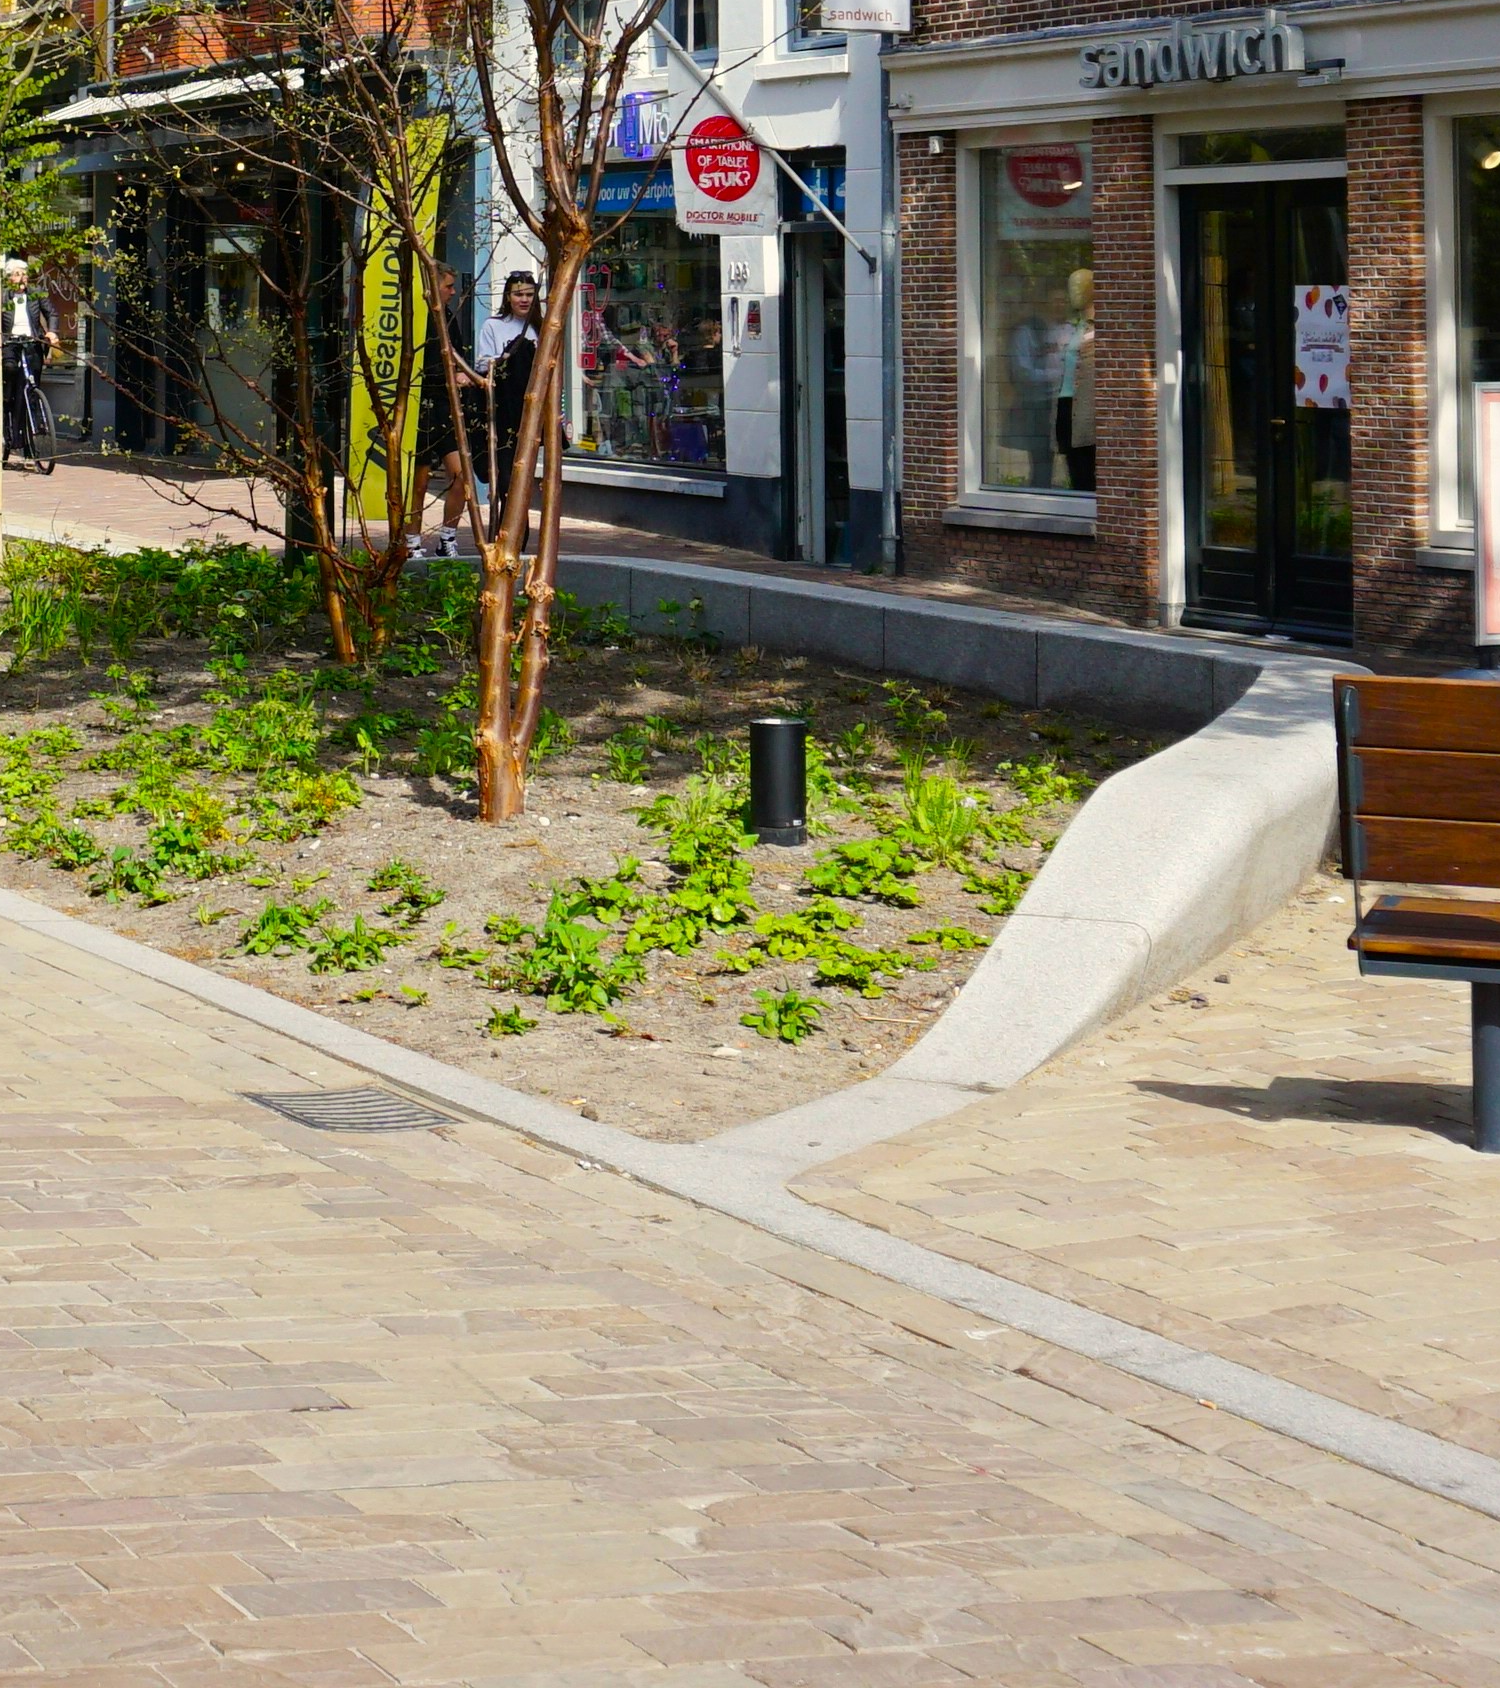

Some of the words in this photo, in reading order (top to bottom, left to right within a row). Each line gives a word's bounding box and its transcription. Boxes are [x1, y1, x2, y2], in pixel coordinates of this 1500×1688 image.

[697, 155, 712, 167] OF
[716, 156, 748, 168] TABLET
[698, 171, 751, 189] STUK?
[686, 210, 724, 220] DOCTOR
[726, 211, 760, 222] MOBILE
